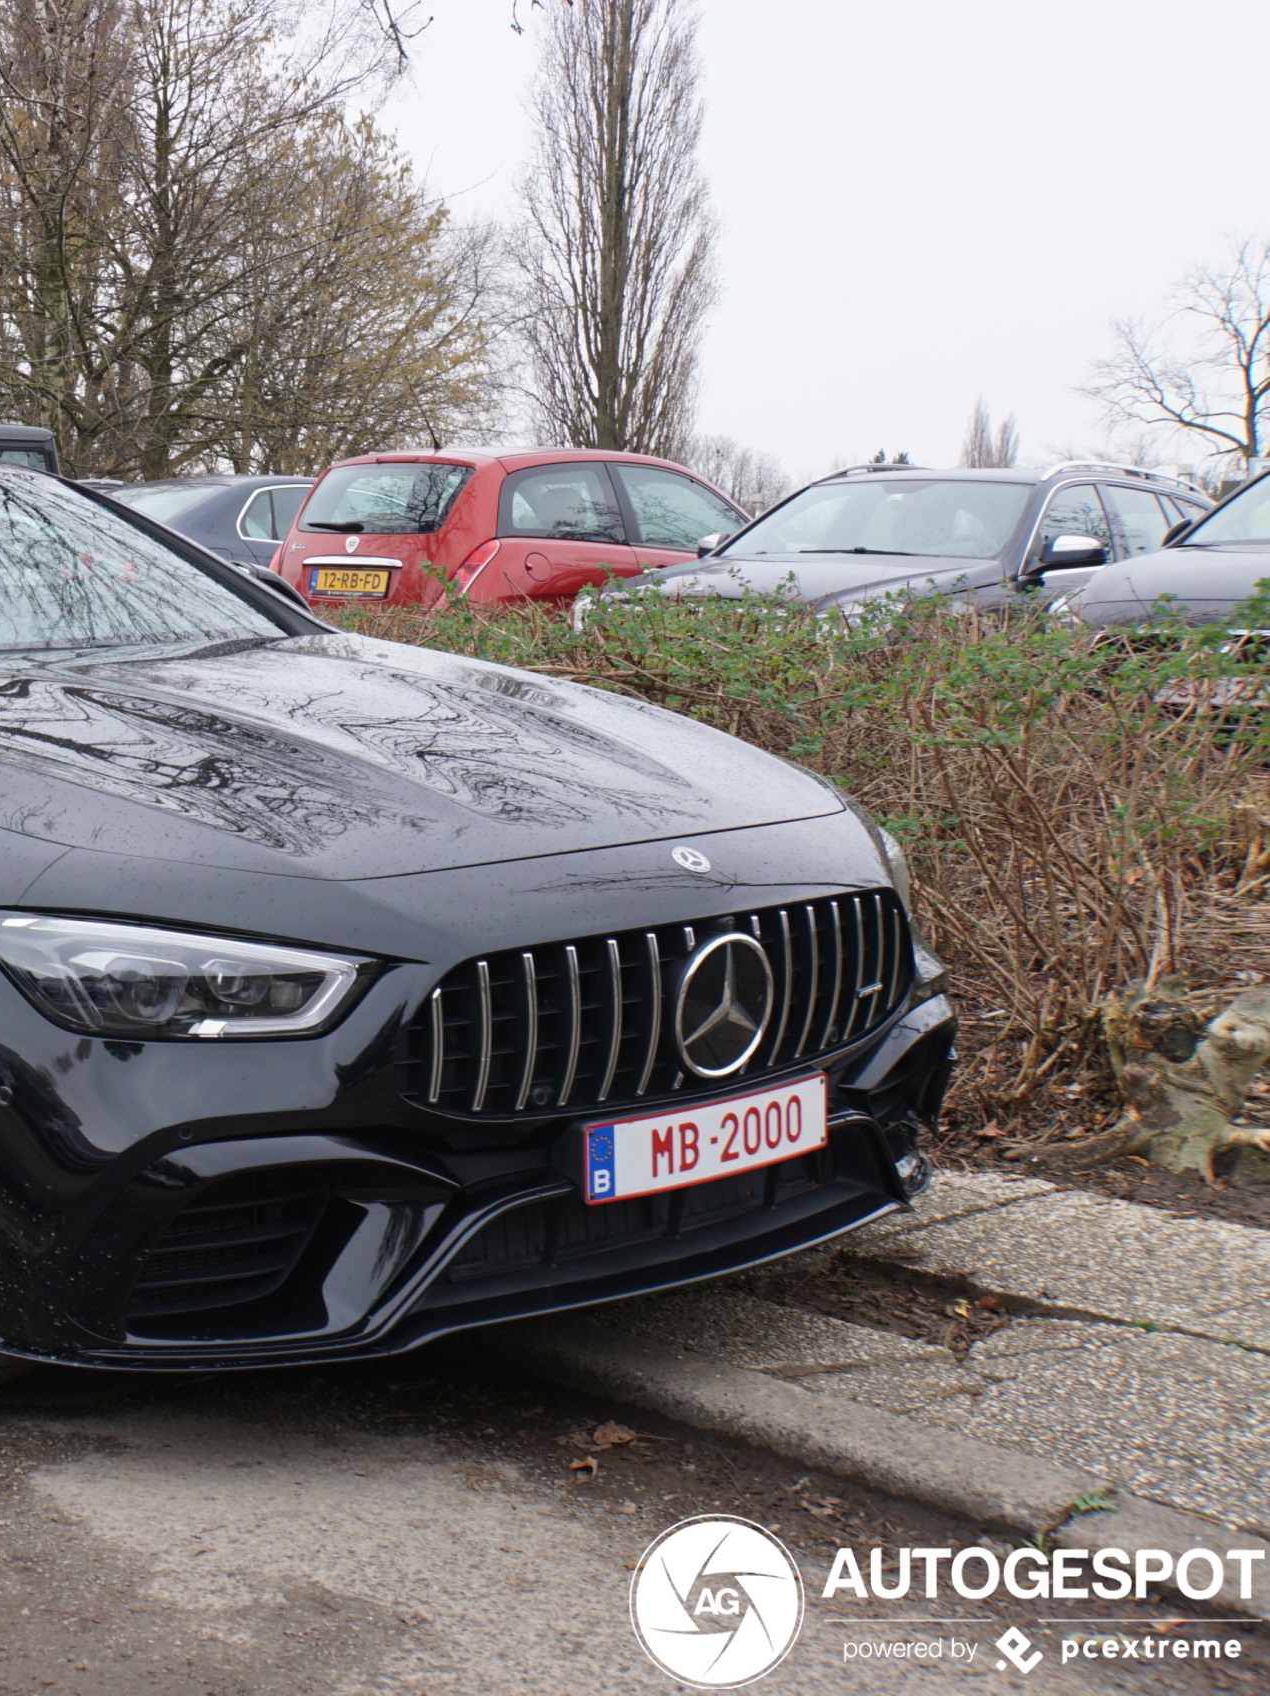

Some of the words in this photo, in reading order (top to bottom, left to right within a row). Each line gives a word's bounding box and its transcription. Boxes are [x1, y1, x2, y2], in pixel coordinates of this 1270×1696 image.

[323, 572, 381, 589] 12-RB-FD
[652, 1095, 802, 1178] MB-2000
[594, 1169, 610, 1193] B
